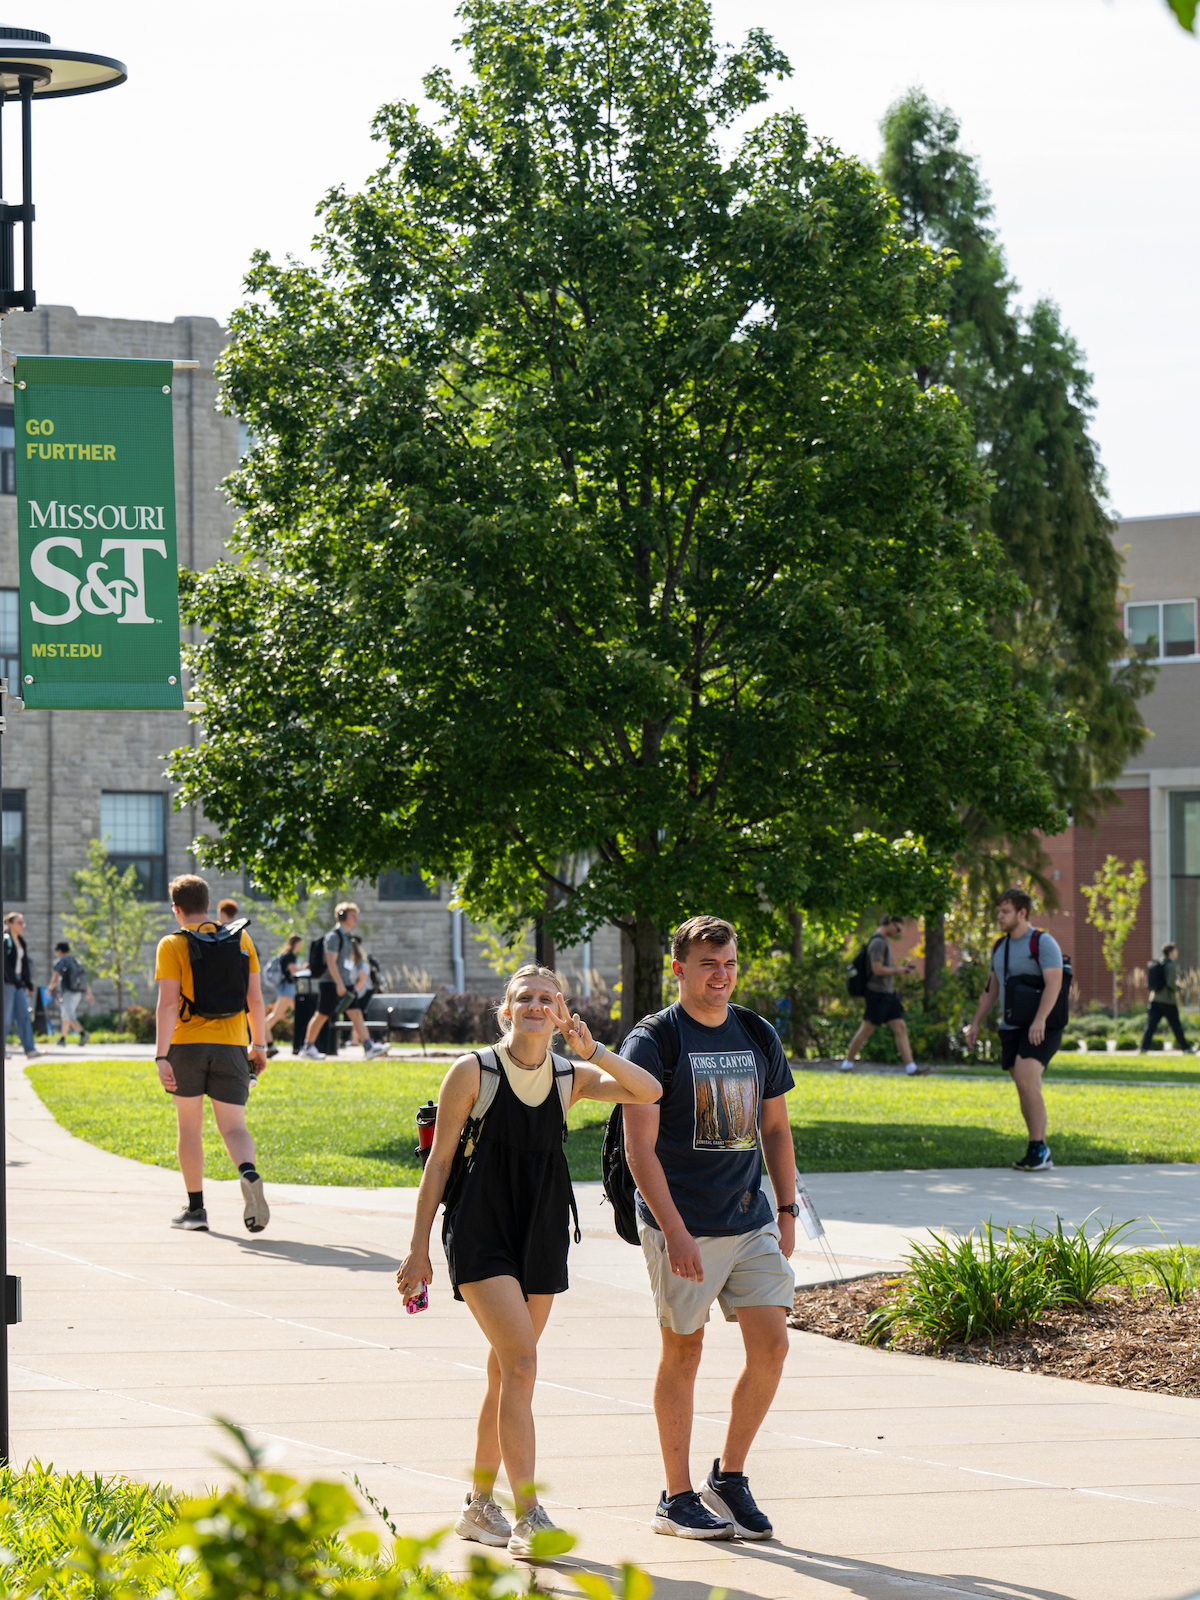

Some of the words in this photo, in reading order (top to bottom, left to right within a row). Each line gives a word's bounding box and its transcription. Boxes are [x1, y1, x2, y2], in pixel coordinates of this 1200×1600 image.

[25, 419, 55, 436] GO
[26, 443, 116, 461] FURTHER
[28, 500, 165, 530] MISSOURI
[29, 536, 167, 625] S&T
[31, 643, 102, 658] MST.EDU
[692, 1056, 717, 1069] KINGS
[720, 1055, 753, 1068] CANYON
